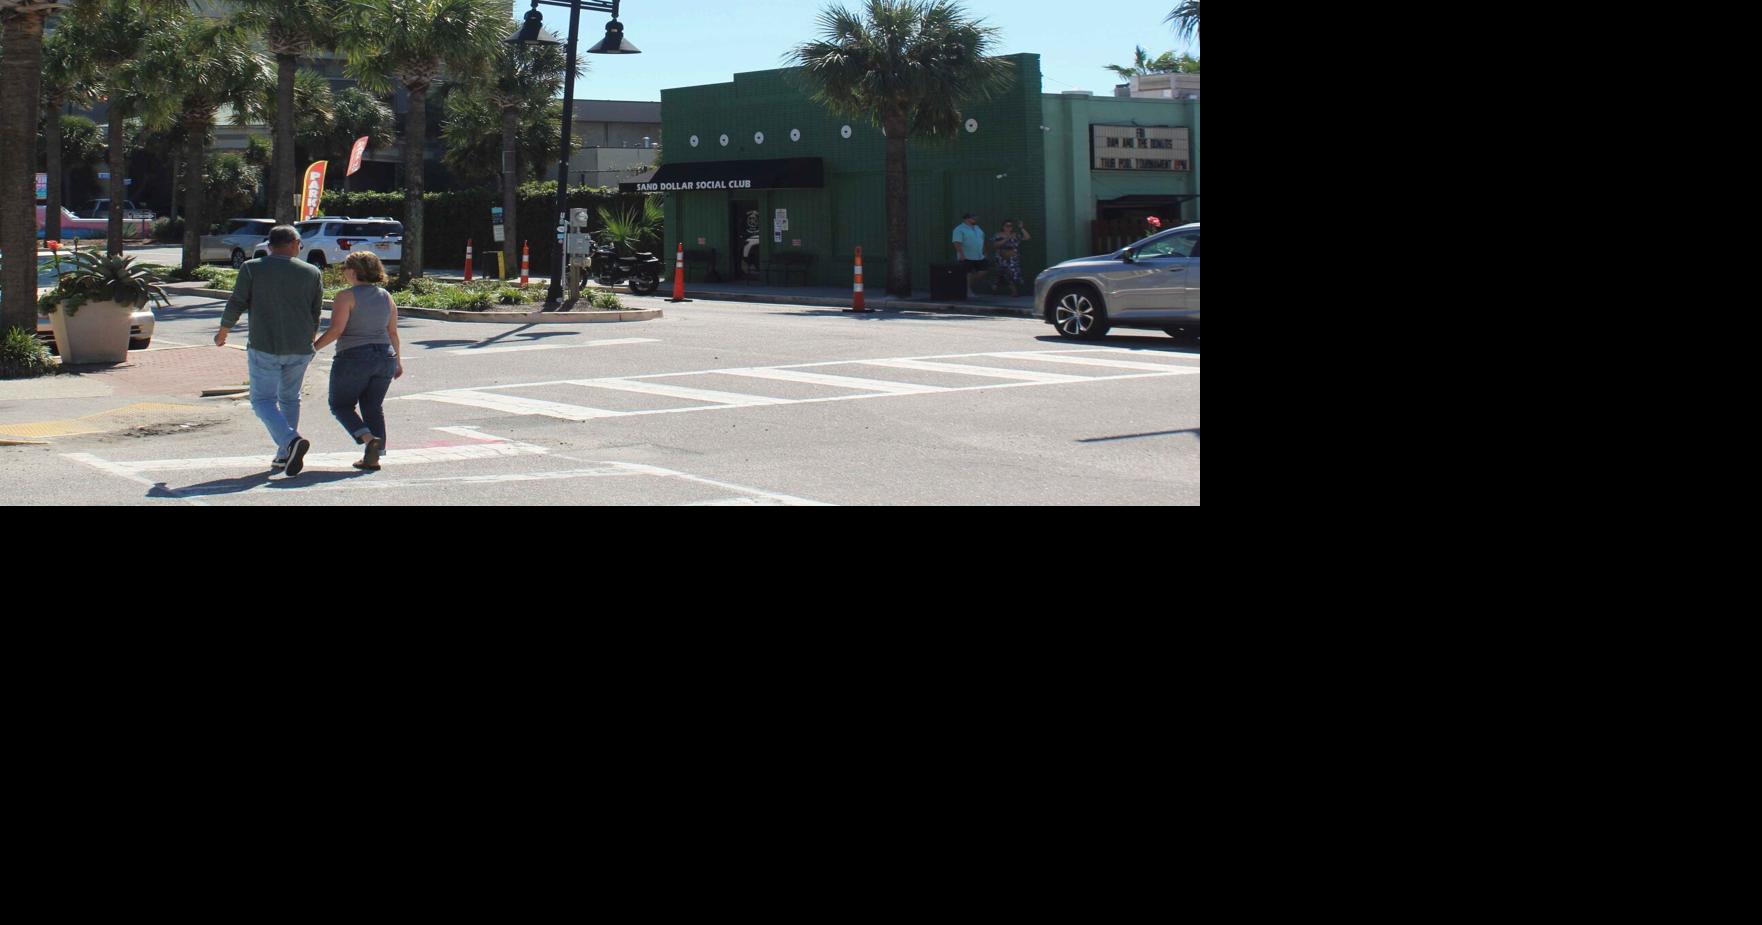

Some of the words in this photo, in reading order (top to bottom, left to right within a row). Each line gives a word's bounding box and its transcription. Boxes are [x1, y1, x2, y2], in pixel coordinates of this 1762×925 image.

[637, 183, 658, 191] SAND
[660, 182, 694, 190] DOLLAR
[696, 181, 727, 189] SOCIAL
[729, 180, 751, 188] CLUB
